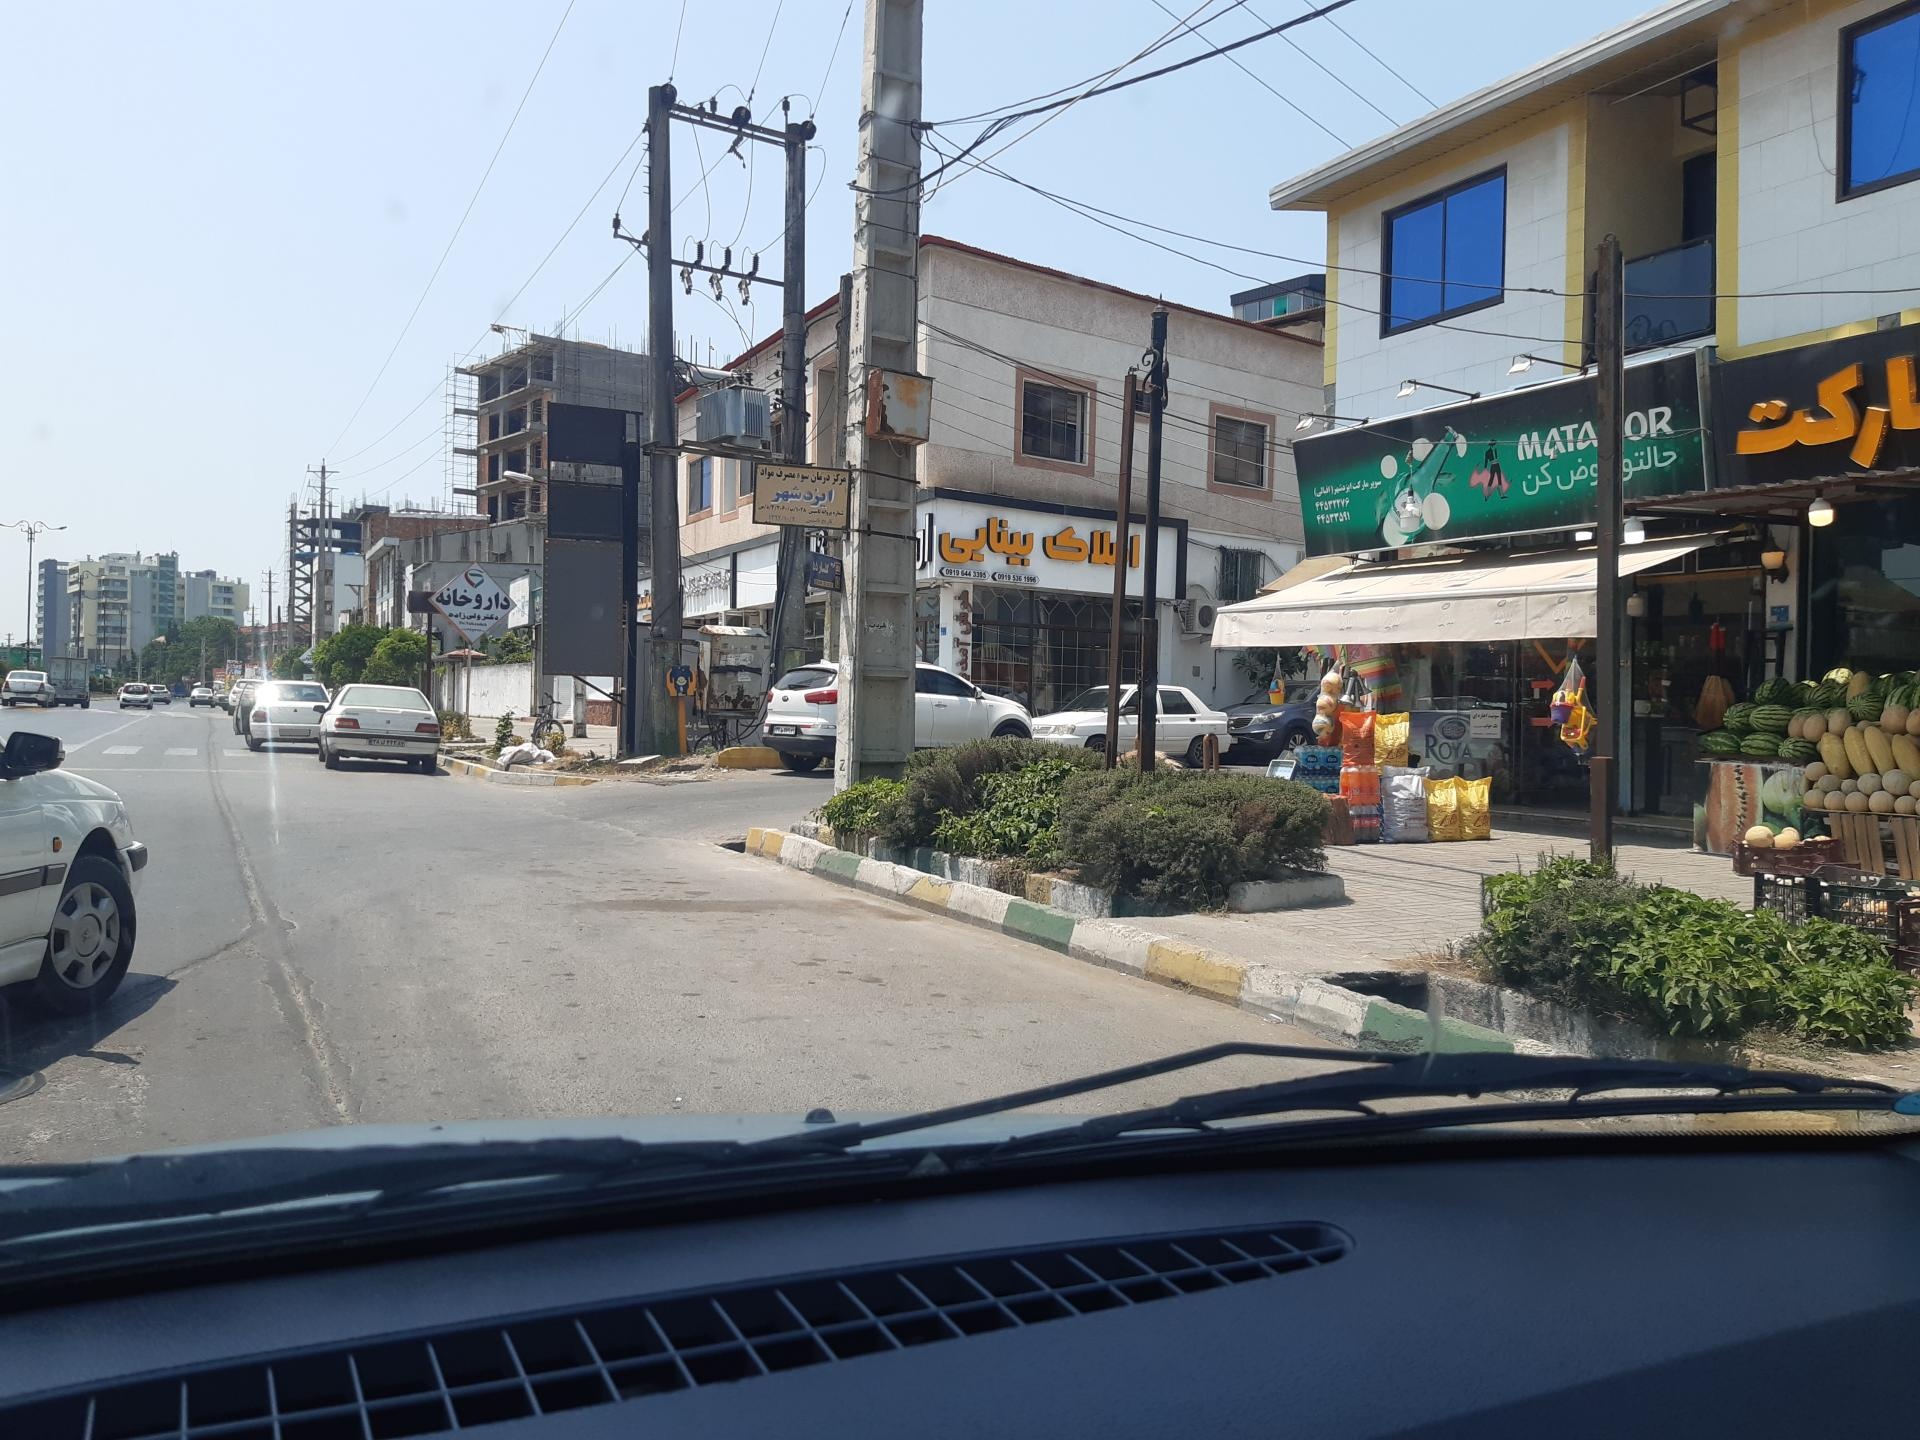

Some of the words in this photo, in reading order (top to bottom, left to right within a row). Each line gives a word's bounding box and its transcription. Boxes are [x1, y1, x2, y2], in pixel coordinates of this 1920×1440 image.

[1736, 355, 1920, 468] ارکت
[1517, 406, 1674, 460] MATAOR
[760, 467, 774, 479] مواد
[776, 467, 795, 481] مصرف
[810, 471, 830, 484] درمان
[832, 473, 847, 485] مرکز
[1522, 461, 1552, 496] کن
[1556, 457, 1599, 491] وض
[938, 516, 1034, 567] بینایی
[1043, 526, 1140, 568] الاک
[436, 588, 511, 610] داروخانه
[482, 612, 500, 621] دکتر
[1425, 734, 1473, 761] ROYA
